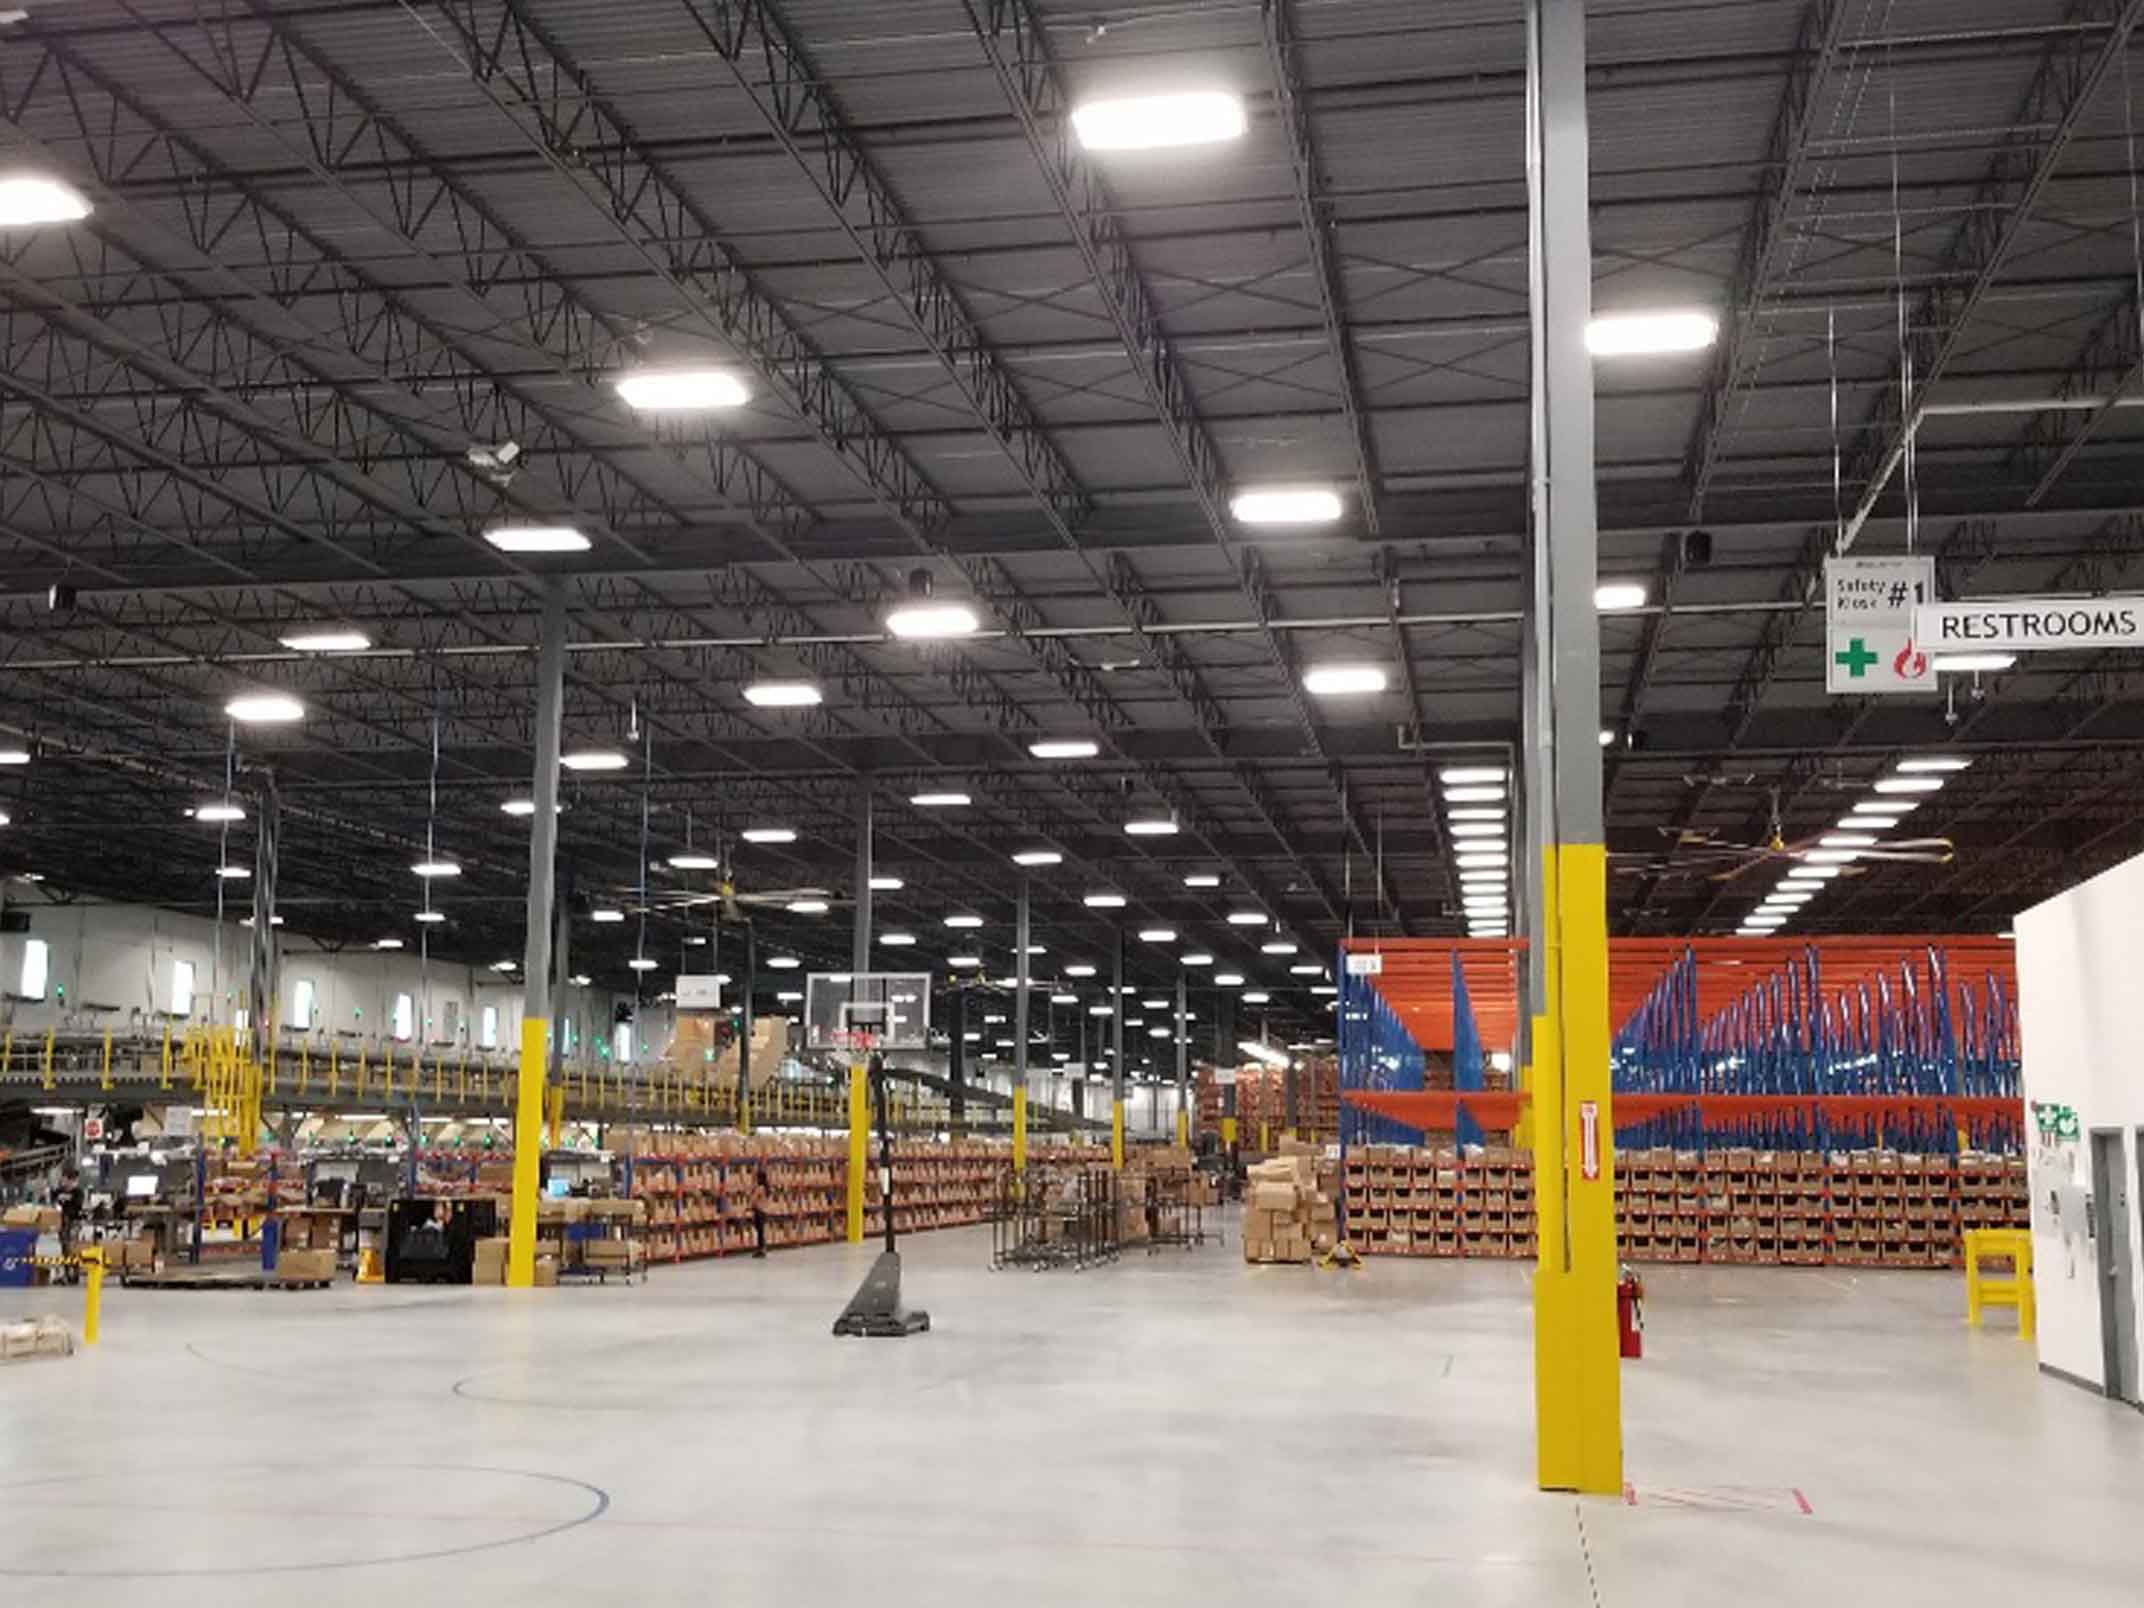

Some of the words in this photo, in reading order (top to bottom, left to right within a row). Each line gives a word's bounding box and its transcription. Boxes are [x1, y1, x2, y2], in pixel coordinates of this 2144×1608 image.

[1837, 579, 1886, 594] Safety
[1887, 581, 1923, 608] #1
[1942, 610, 2137, 639] RESTROOMS
